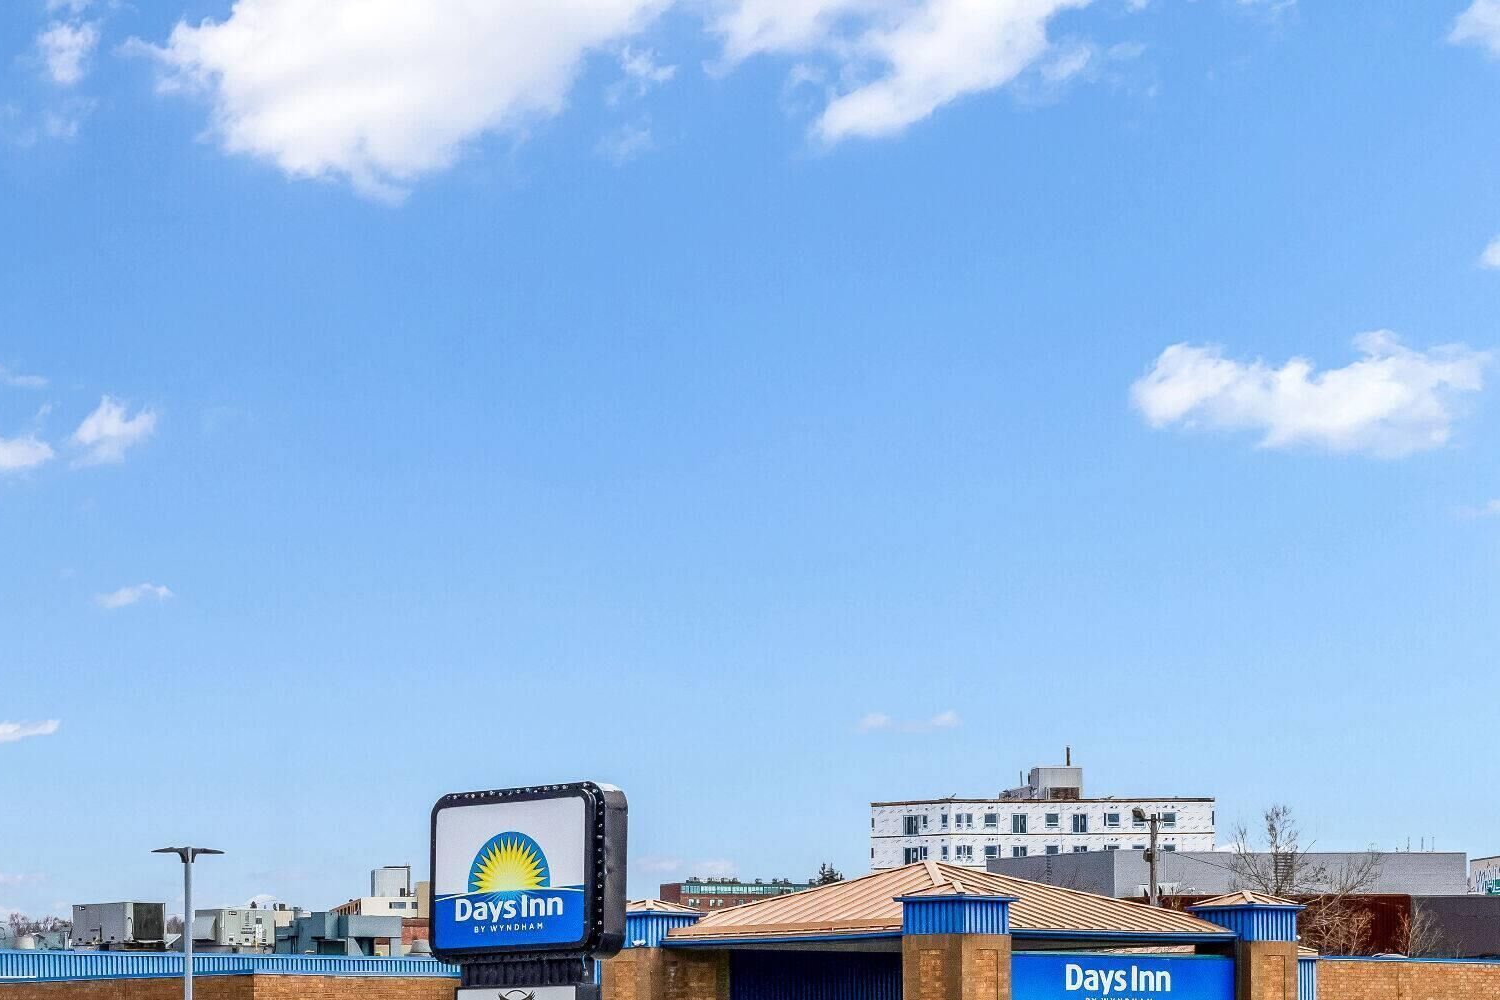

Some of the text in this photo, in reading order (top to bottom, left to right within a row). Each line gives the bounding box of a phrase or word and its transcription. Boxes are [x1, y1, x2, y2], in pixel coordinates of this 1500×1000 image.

[455, 895, 563, 923] Days Inn
[474, 923, 543, 934] BY WYNDHAM
[1065, 964, 1171, 995] Days Inn
